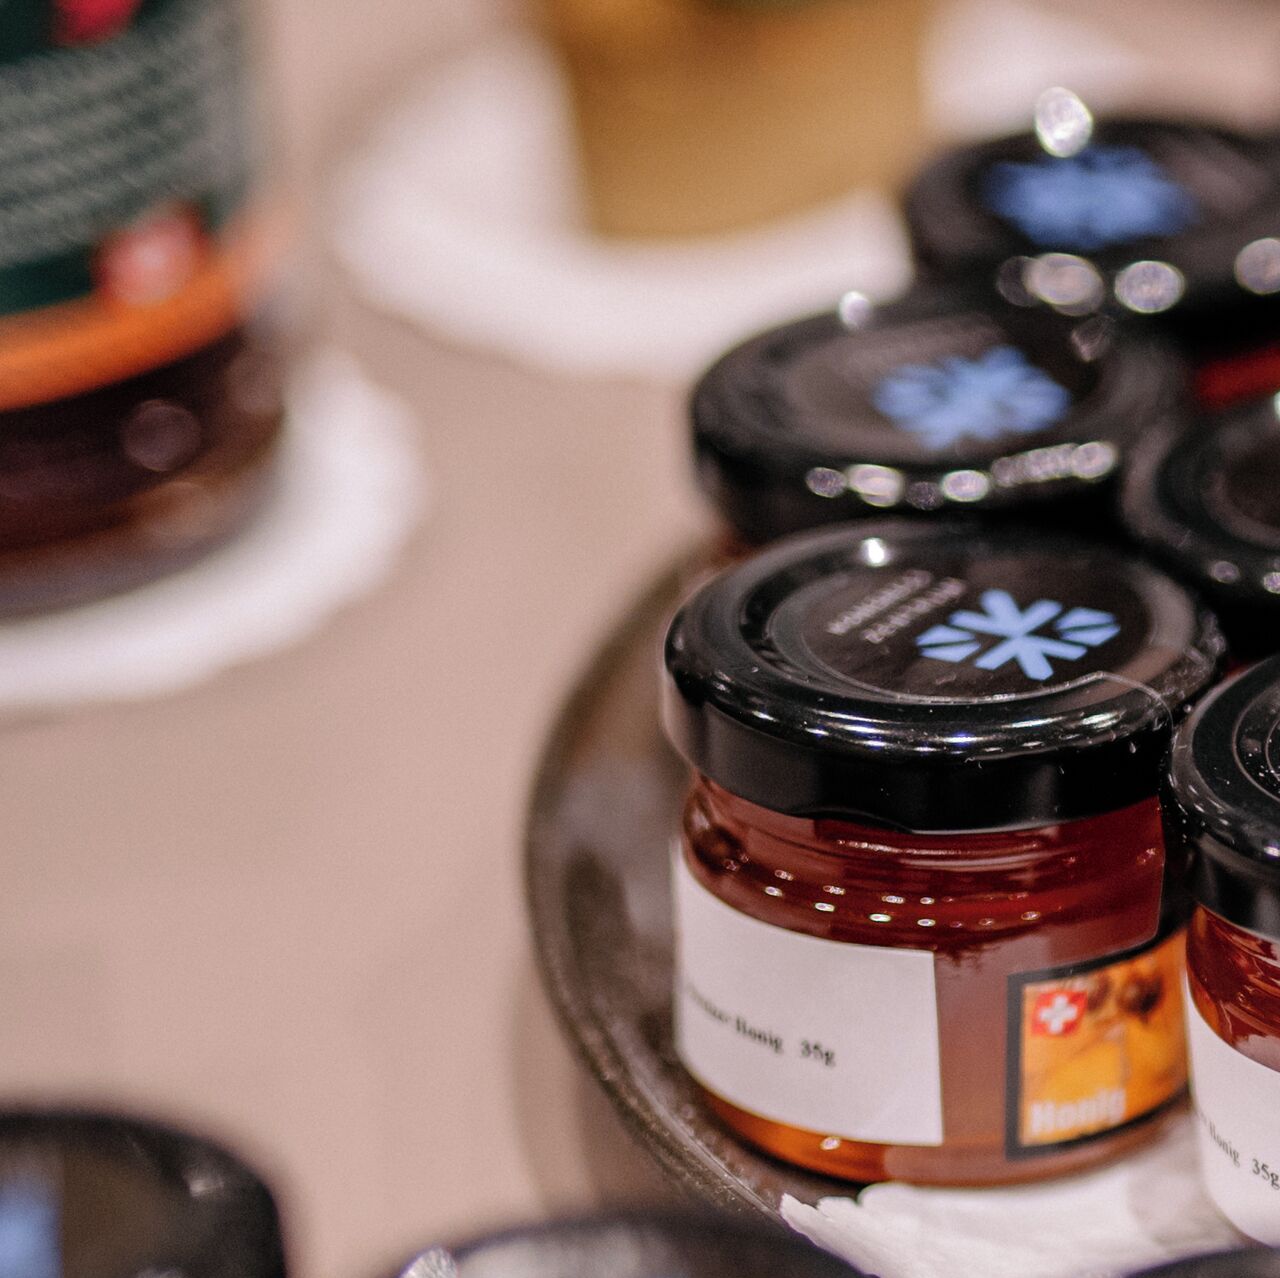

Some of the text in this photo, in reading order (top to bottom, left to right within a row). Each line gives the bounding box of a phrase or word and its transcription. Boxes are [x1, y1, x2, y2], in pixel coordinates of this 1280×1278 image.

[801, 1040, 836, 1067] 35g
[1209, 1120, 1280, 1191] Honig 35g
